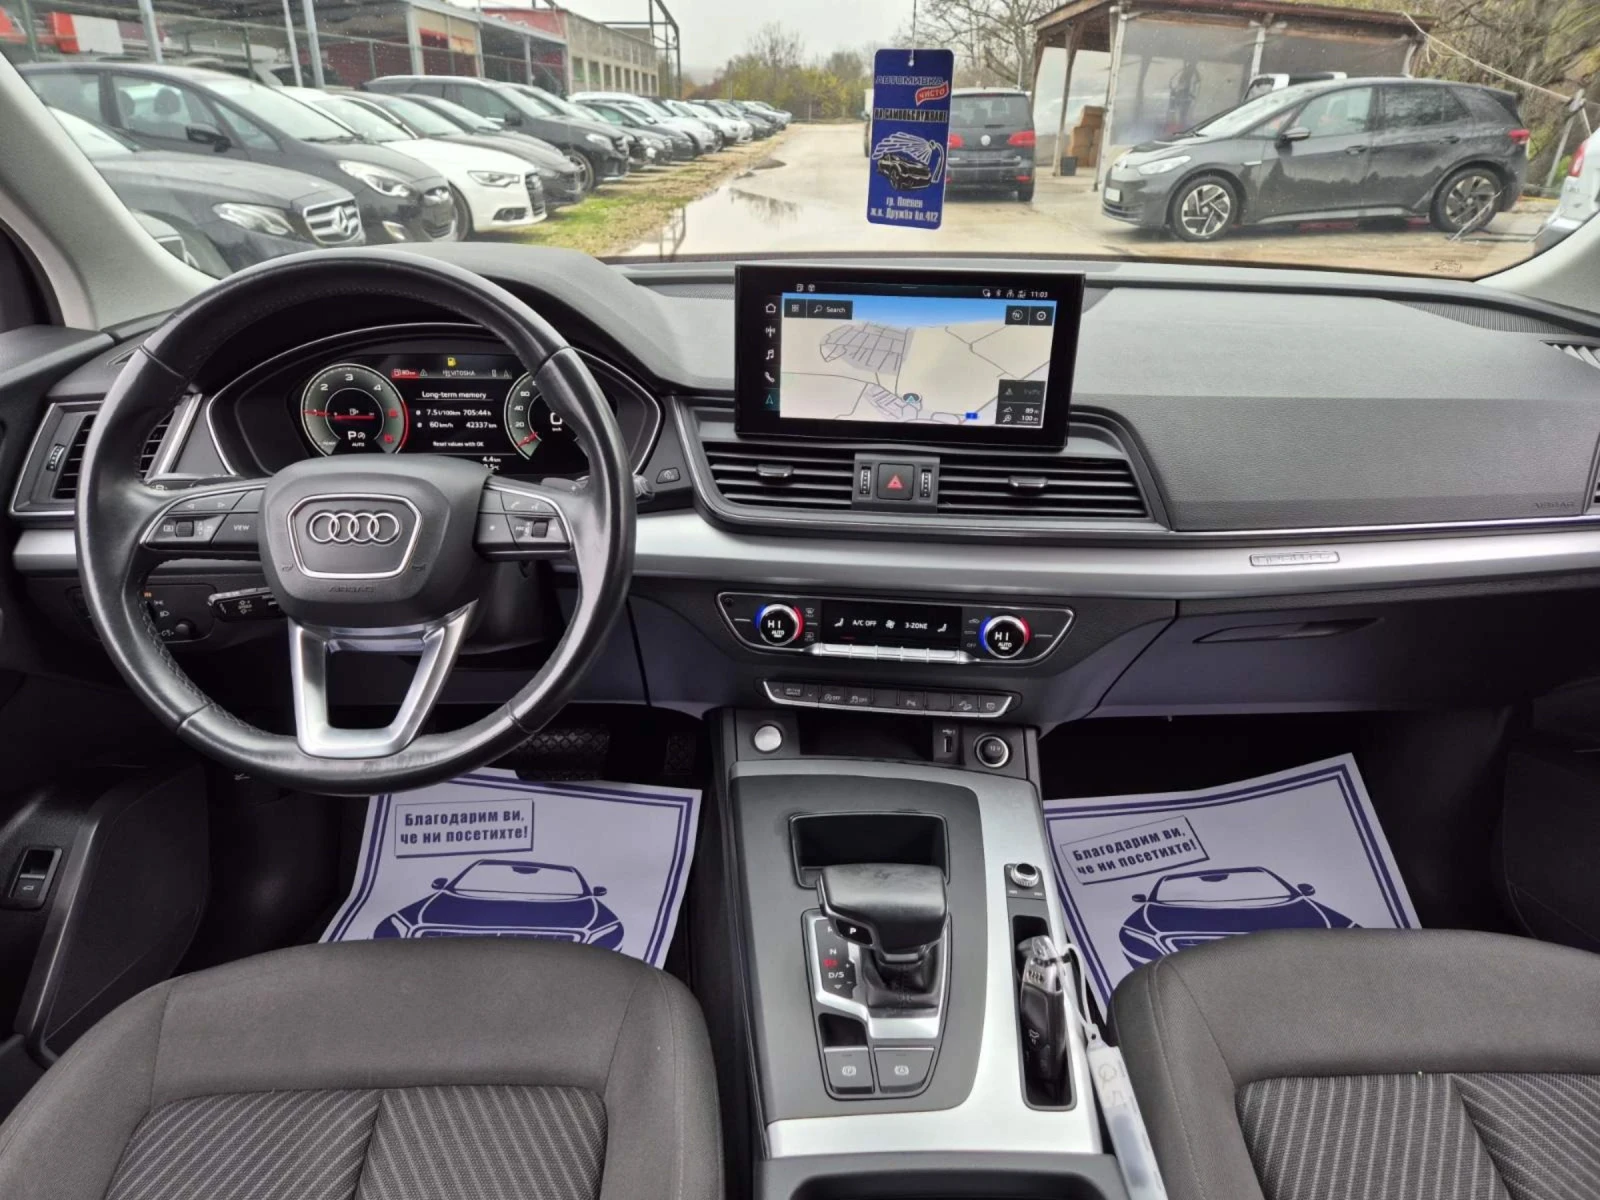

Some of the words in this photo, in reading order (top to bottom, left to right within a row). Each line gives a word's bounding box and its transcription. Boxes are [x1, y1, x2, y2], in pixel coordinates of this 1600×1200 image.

[918, 87, 945, 99] ЧИСТО
[345, 373, 354, 381] 3
[421, 391, 458, 400] Long-term
[458, 392, 487, 400] memory
[347, 431, 356, 440] P
[864, 619, 877, 627] OFF
[904, 622, 928, 630] 3-ZONE
[405, 811, 498, 826] Благодарим
[400, 833, 418, 845] че
[422, 832, 441, 843] ни
[446, 825, 528, 842] посетихте!
[1072, 832, 1160, 861] Благодарим
[1077, 864, 1095, 875] че
[1097, 859, 1116, 872] ни
[1118, 838, 1198, 868] посетихте!
[828, 971, 844, 979] D/S
